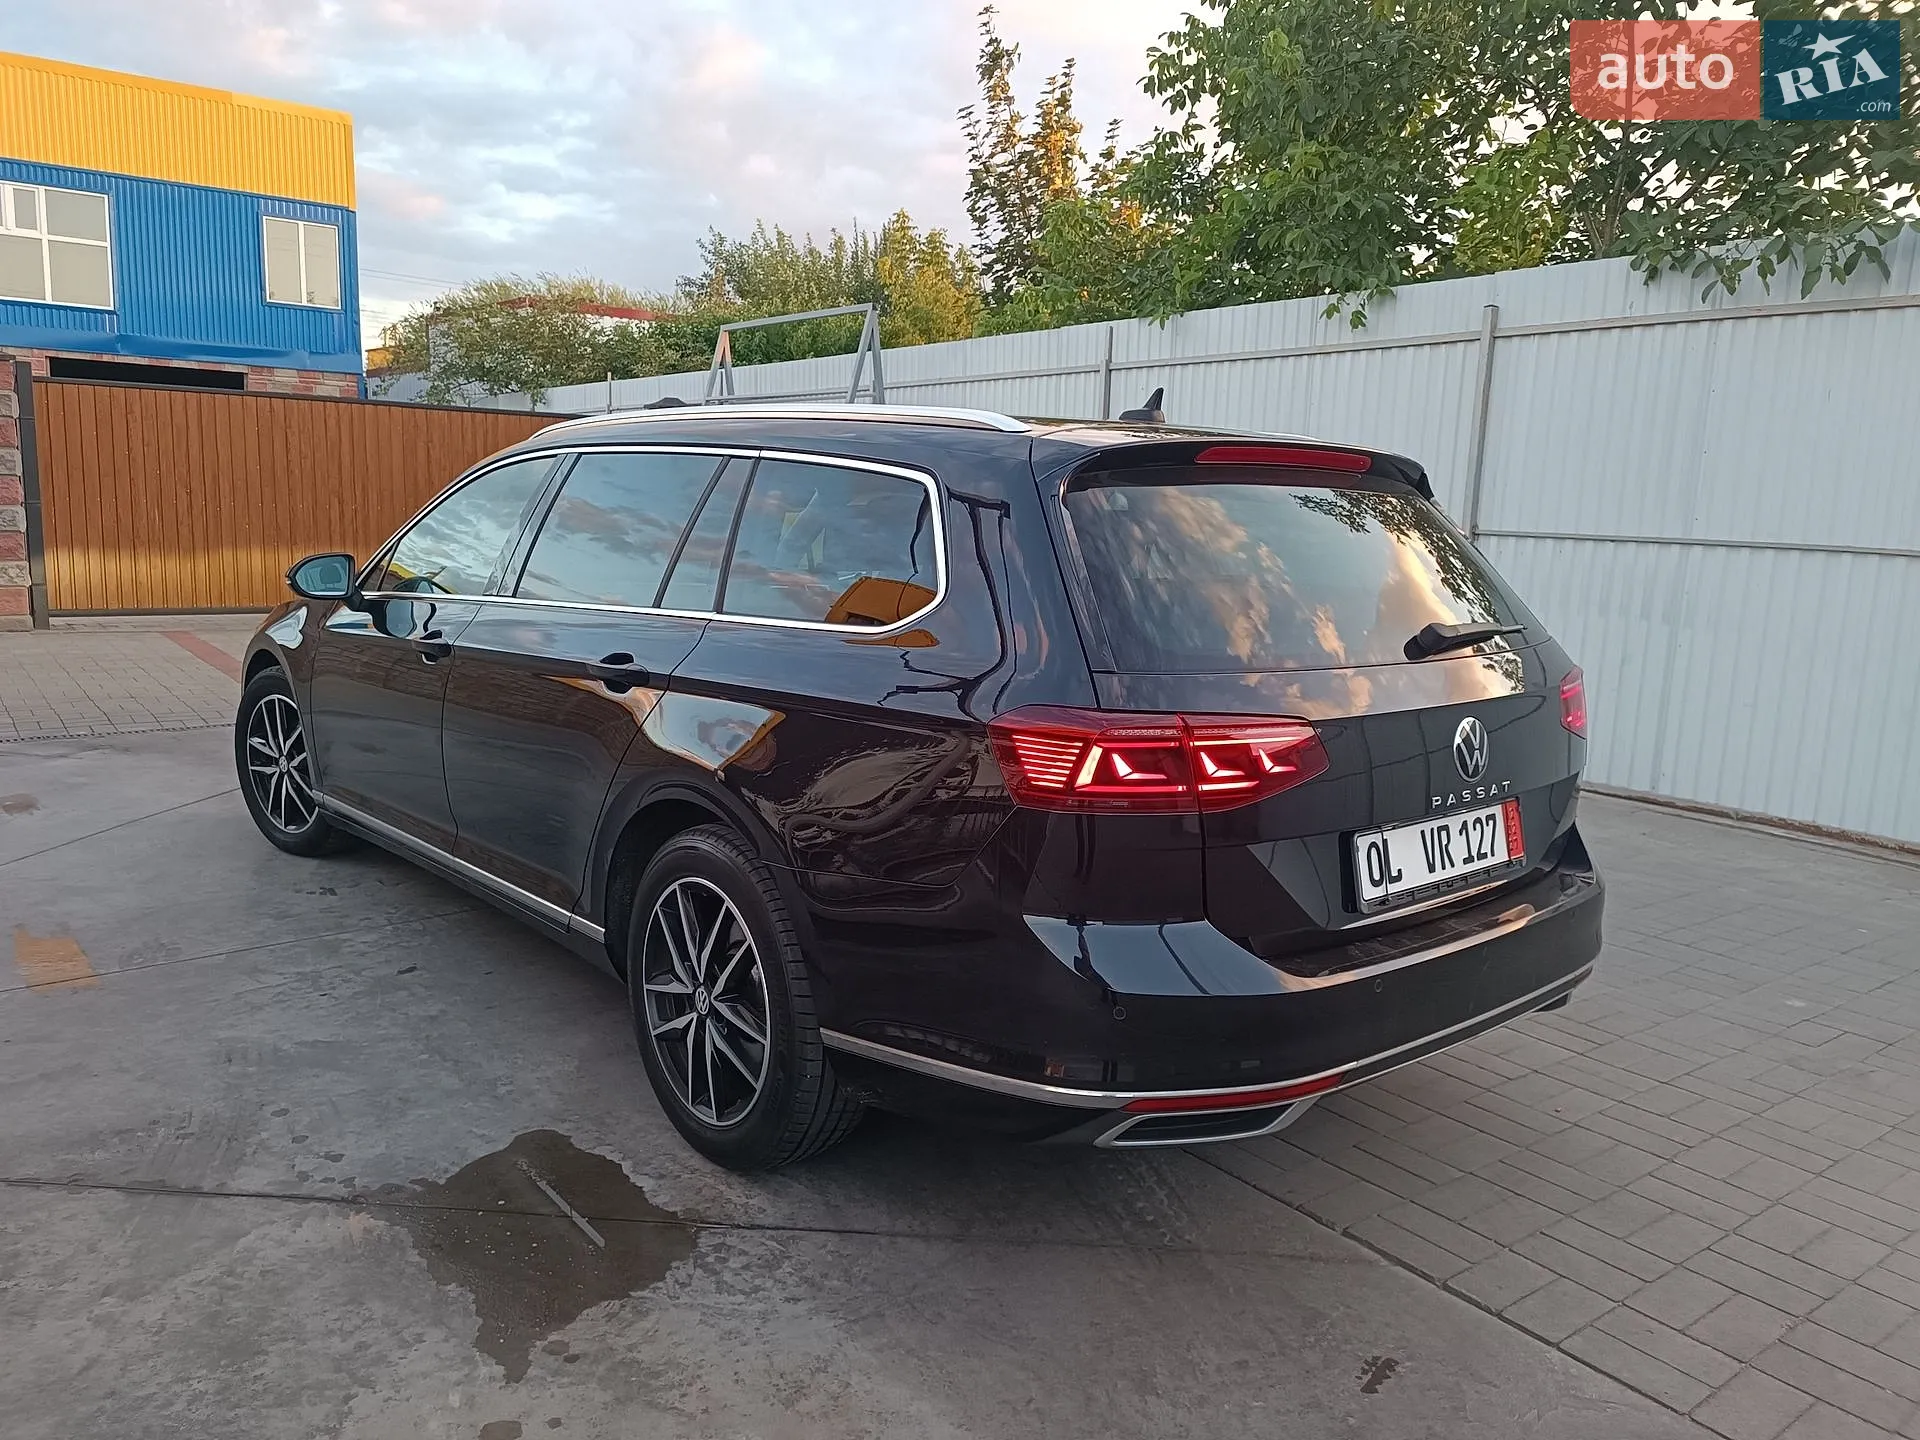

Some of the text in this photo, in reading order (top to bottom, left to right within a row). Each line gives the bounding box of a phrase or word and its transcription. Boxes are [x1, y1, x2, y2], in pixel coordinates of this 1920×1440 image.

[1431, 780, 1512, 809] PASSAT
[1366, 813, 1497, 888] OL VR 127
